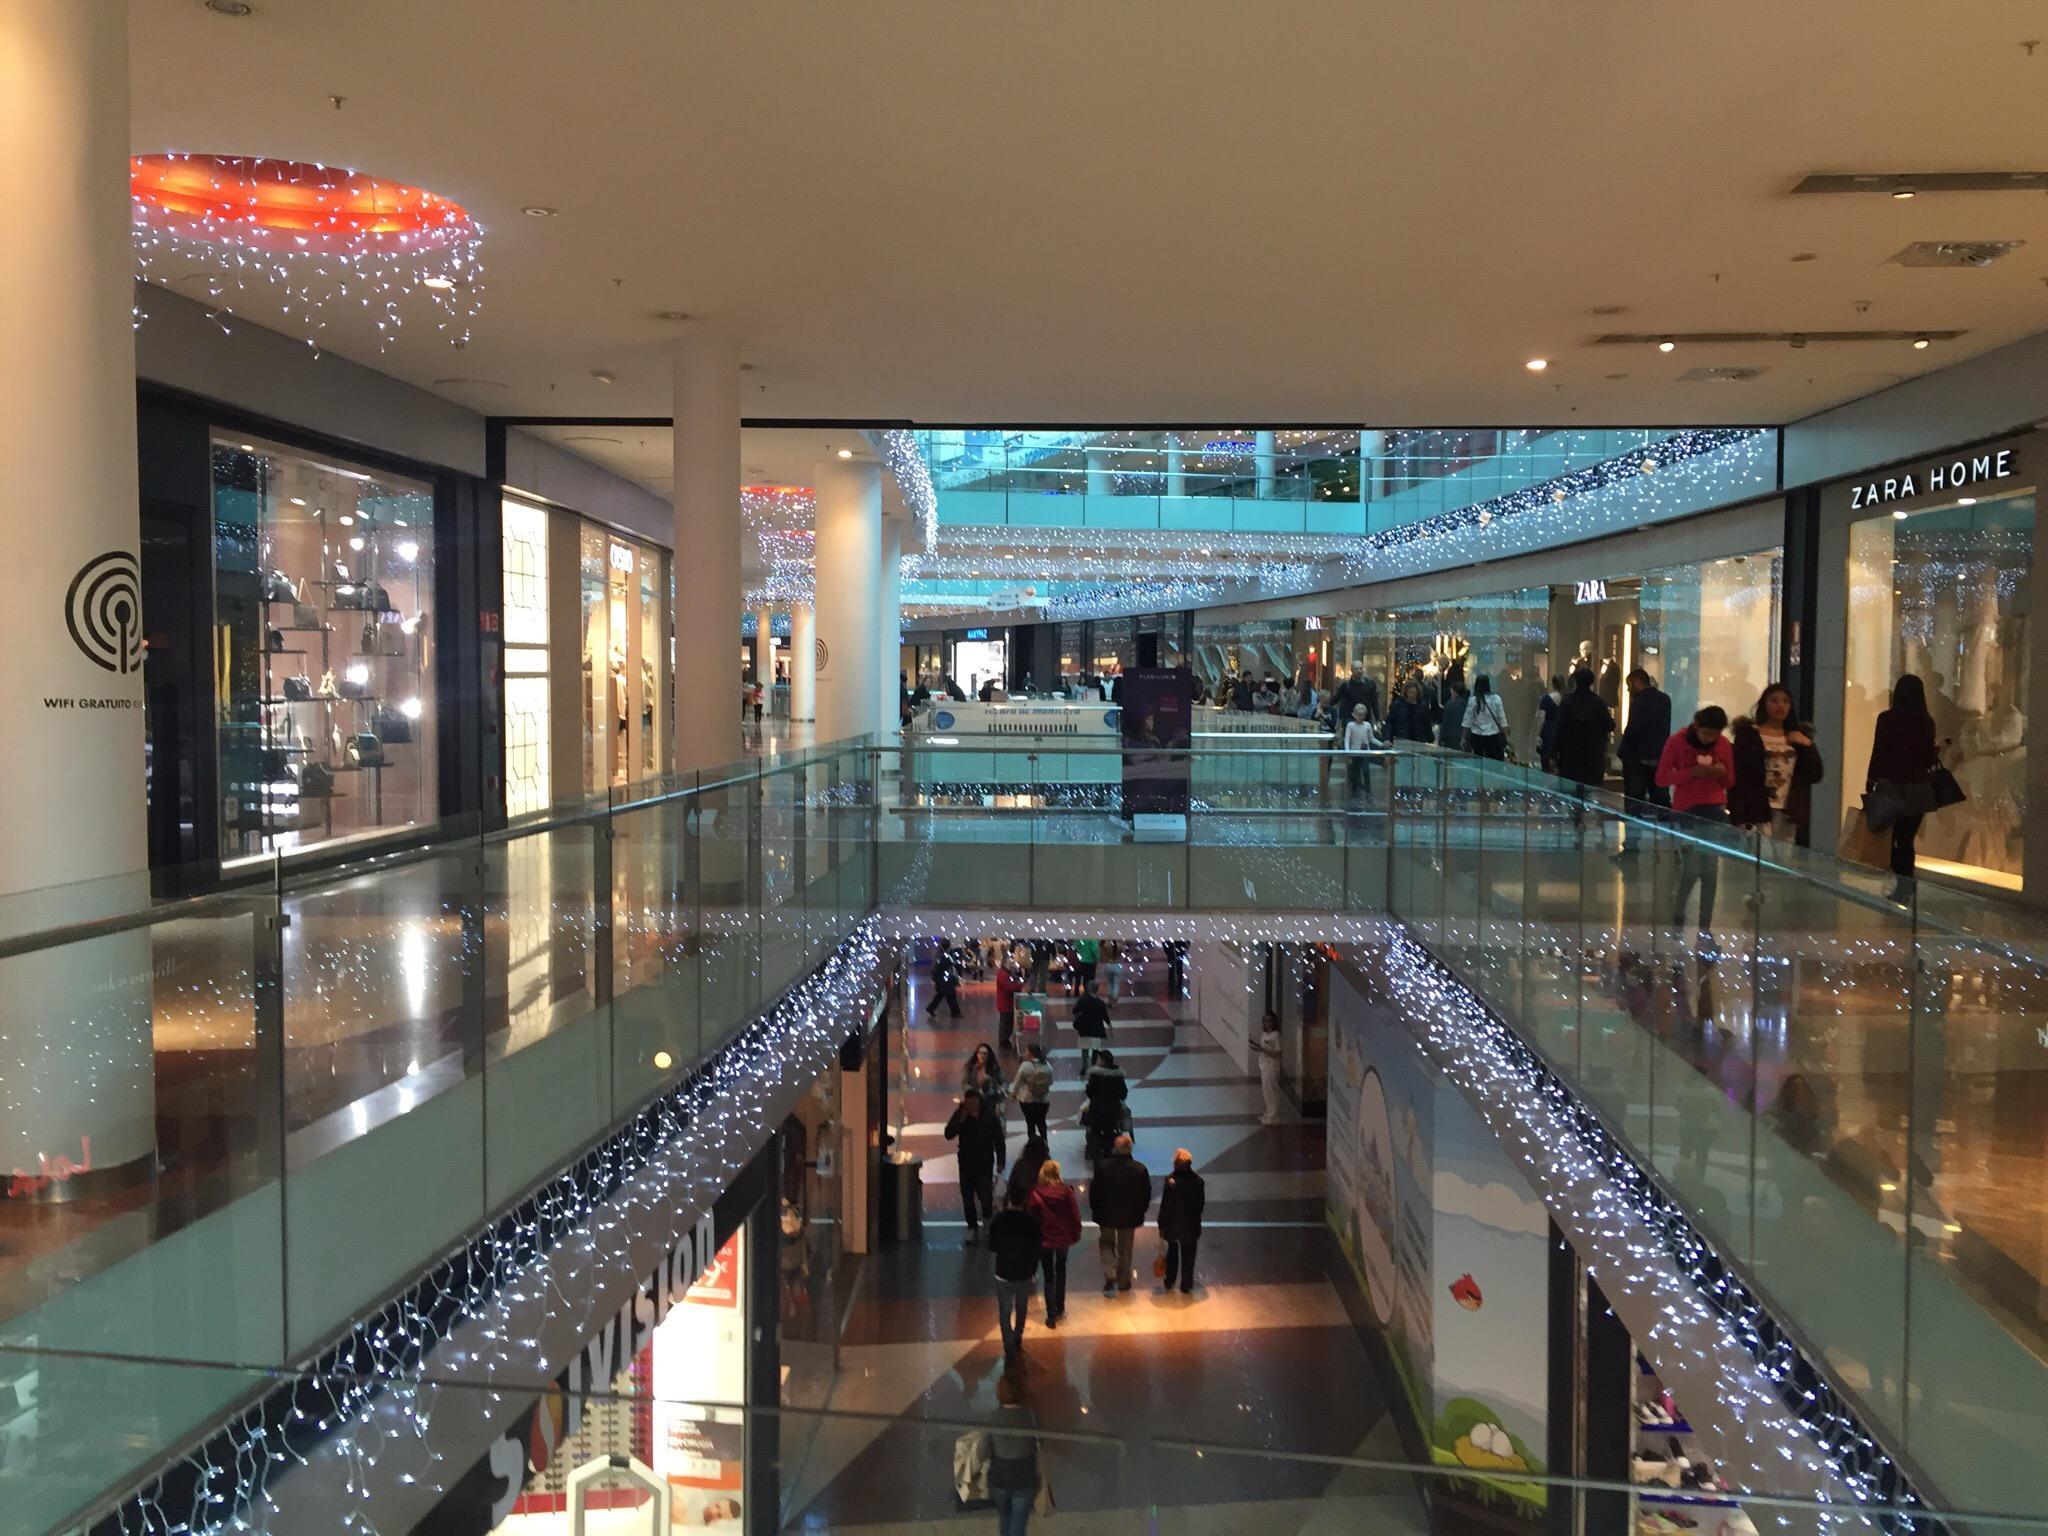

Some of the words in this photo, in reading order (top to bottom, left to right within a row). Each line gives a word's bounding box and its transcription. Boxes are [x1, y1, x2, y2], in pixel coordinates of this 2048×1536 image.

[1851, 475, 1915, 509] ZARA
[1931, 450, 2011, 491] HOME
[1576, 579, 1607, 602] ZARA
[43, 698, 75, 708] WIFI
[79, 698, 131, 709] GRATUITO
